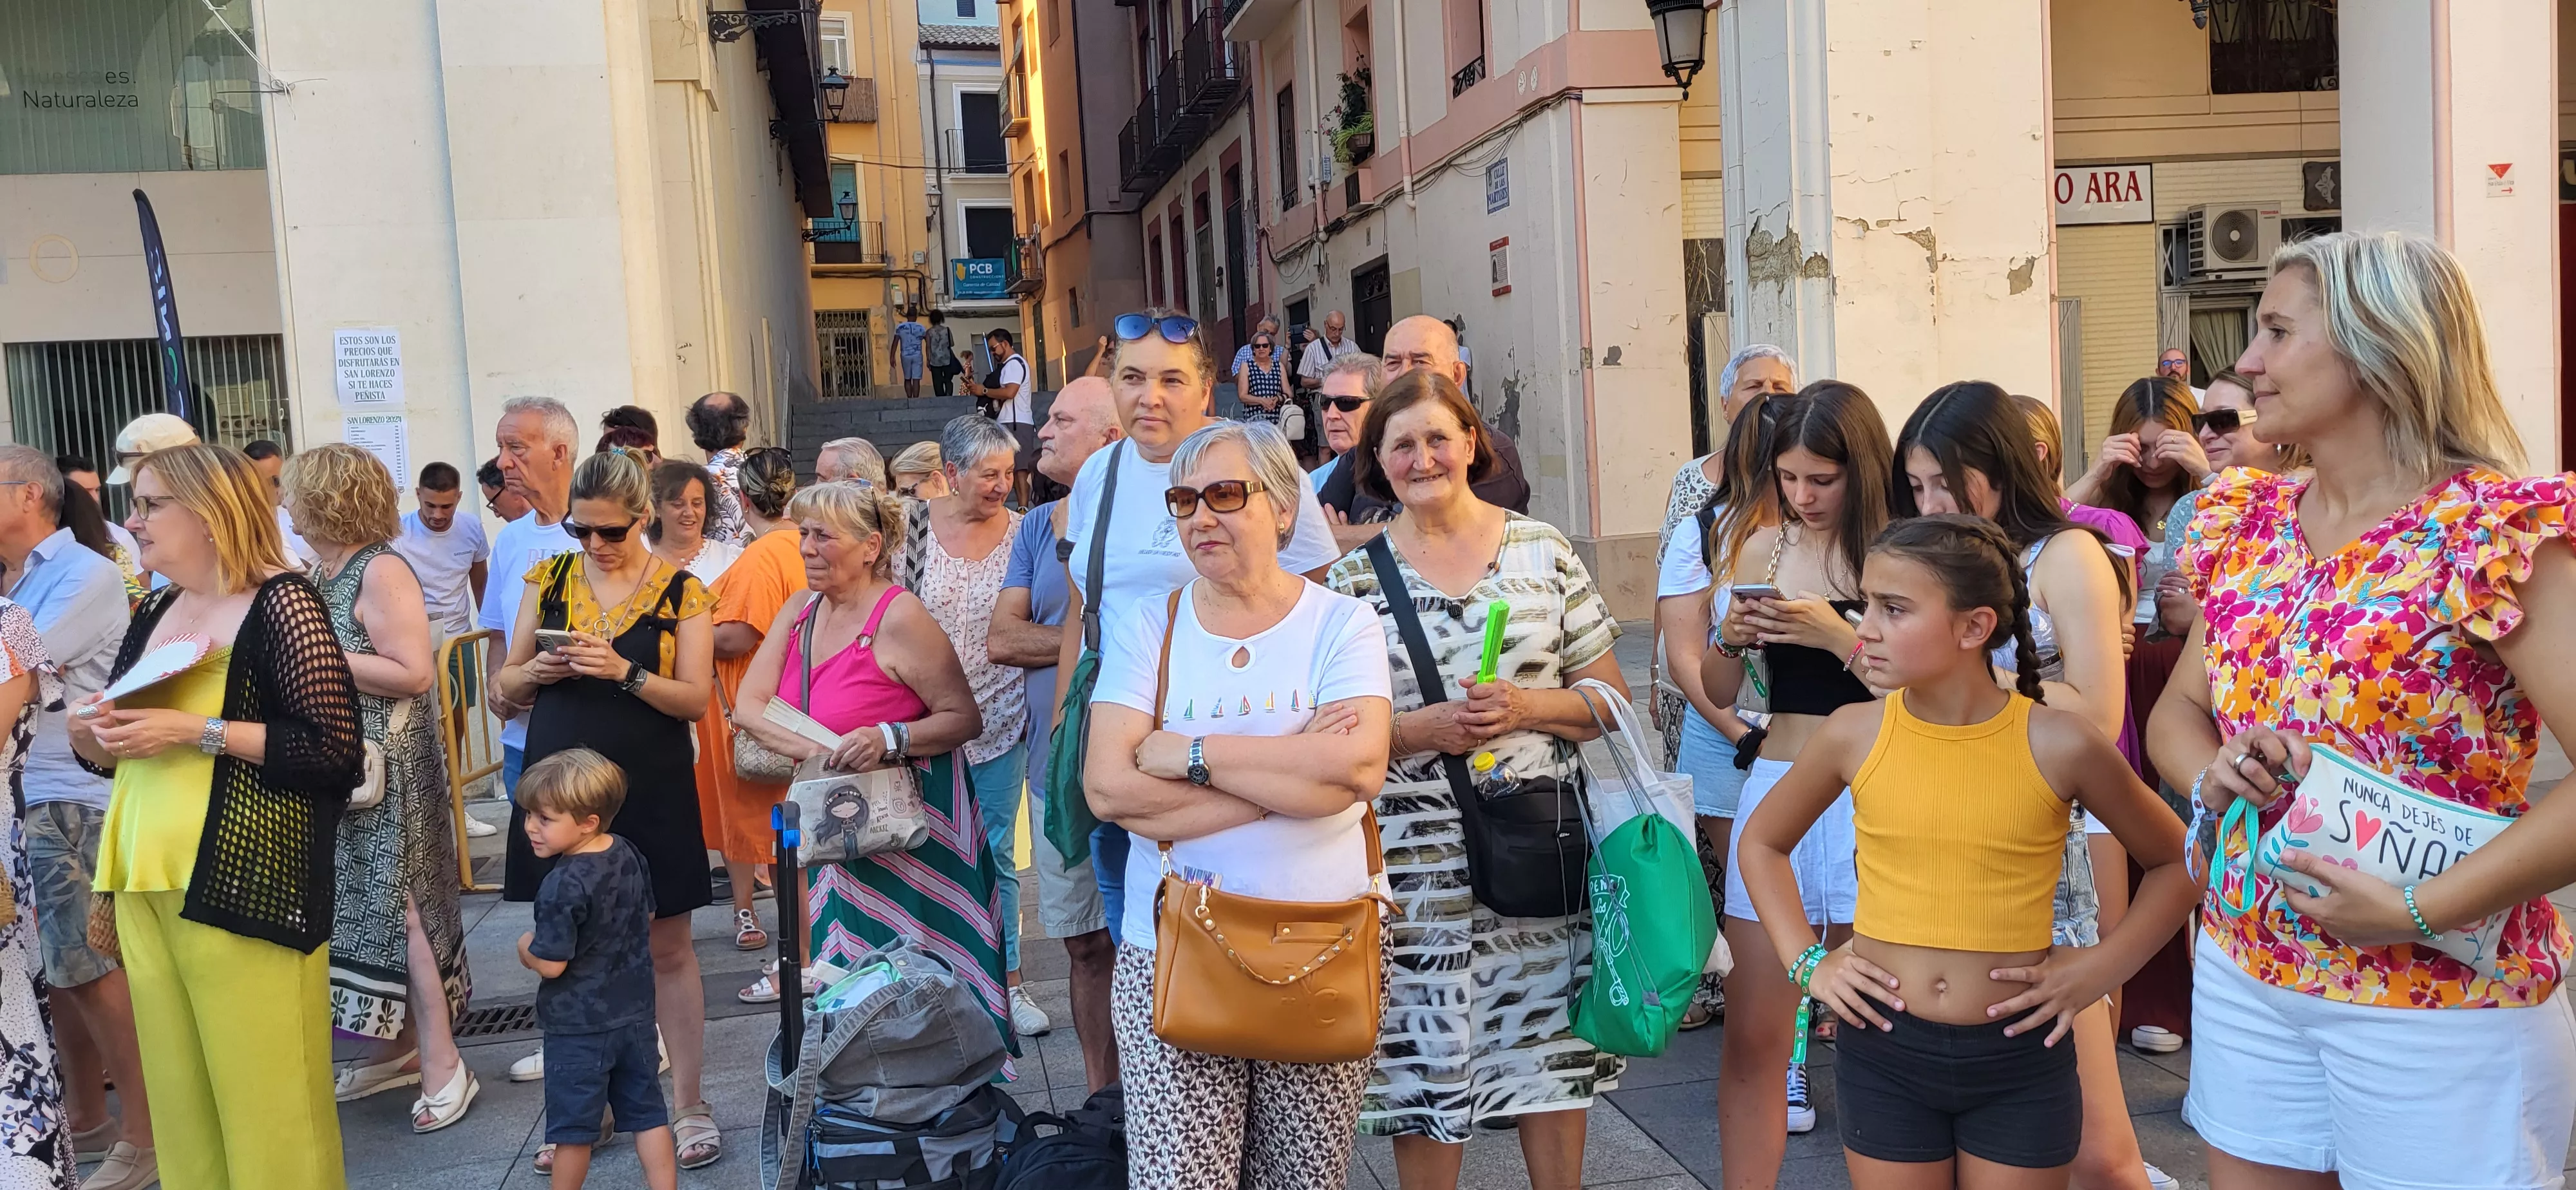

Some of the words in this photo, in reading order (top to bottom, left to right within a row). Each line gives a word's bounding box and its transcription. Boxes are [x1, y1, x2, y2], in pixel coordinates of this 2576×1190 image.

[23, 90, 138, 108] Naturaleza
[1494, 166, 1504, 180] CALLE
[1495, 181, 1499, 189] DE
[2085, 171, 2143, 203] ARA
[969, 263, 993, 274] PCB
[339, 337, 363, 345] ESTOS
[365, 335, 379, 344] SON
[381, 335, 396, 344] LOS
[344, 347, 375, 355] PRECIOS
[377, 347, 393, 356] QUE
[338, 357, 388, 367] DISFRUTARÁS
[390, 357, 400, 366] EN
[344, 370, 359, 378] SAN
[361, 369, 395, 378] LORENZO
[348, 381, 355, 389] SI
[357, 380, 367, 389] TE
[369, 380, 393, 388] HACES
[355, 390, 386, 400] PEÑISTA
[2343, 777, 2391, 813] NUNCA
[2401, 804, 2446, 834] DEJES
[2454, 825, 2474, 846] DE
